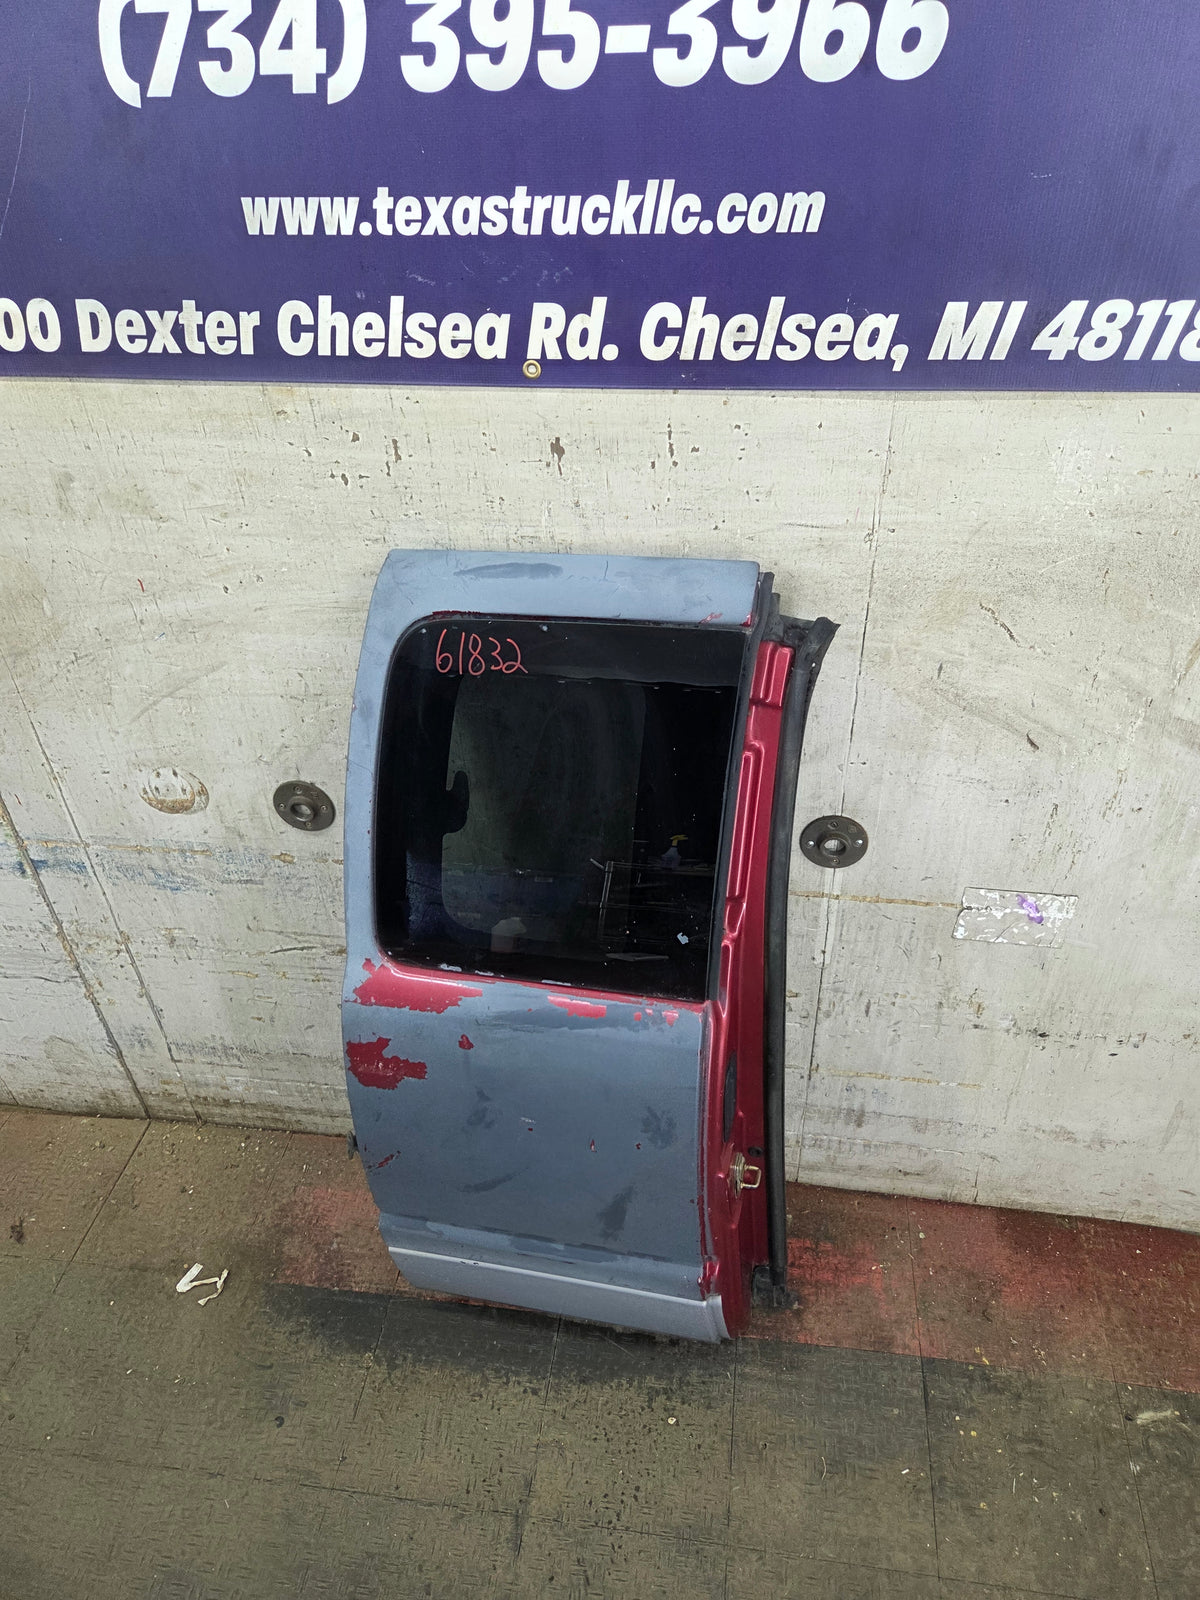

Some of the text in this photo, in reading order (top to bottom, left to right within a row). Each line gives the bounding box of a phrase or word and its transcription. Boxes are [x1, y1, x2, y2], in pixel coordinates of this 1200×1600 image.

[98, 0, 949, 108] (734) 395-3966
[240, 178, 826, 236] www.texastruckllc.com
[0, 297, 61, 353] 00
[75, 298, 260, 356] Dexter
[276, 294, 511, 360] Chelsea
[526, 295, 618, 361] Rd.
[639, 295, 909, 372] Chelsea,
[926, 300, 1028, 361] MI
[435, 628, 529, 676] 61832
